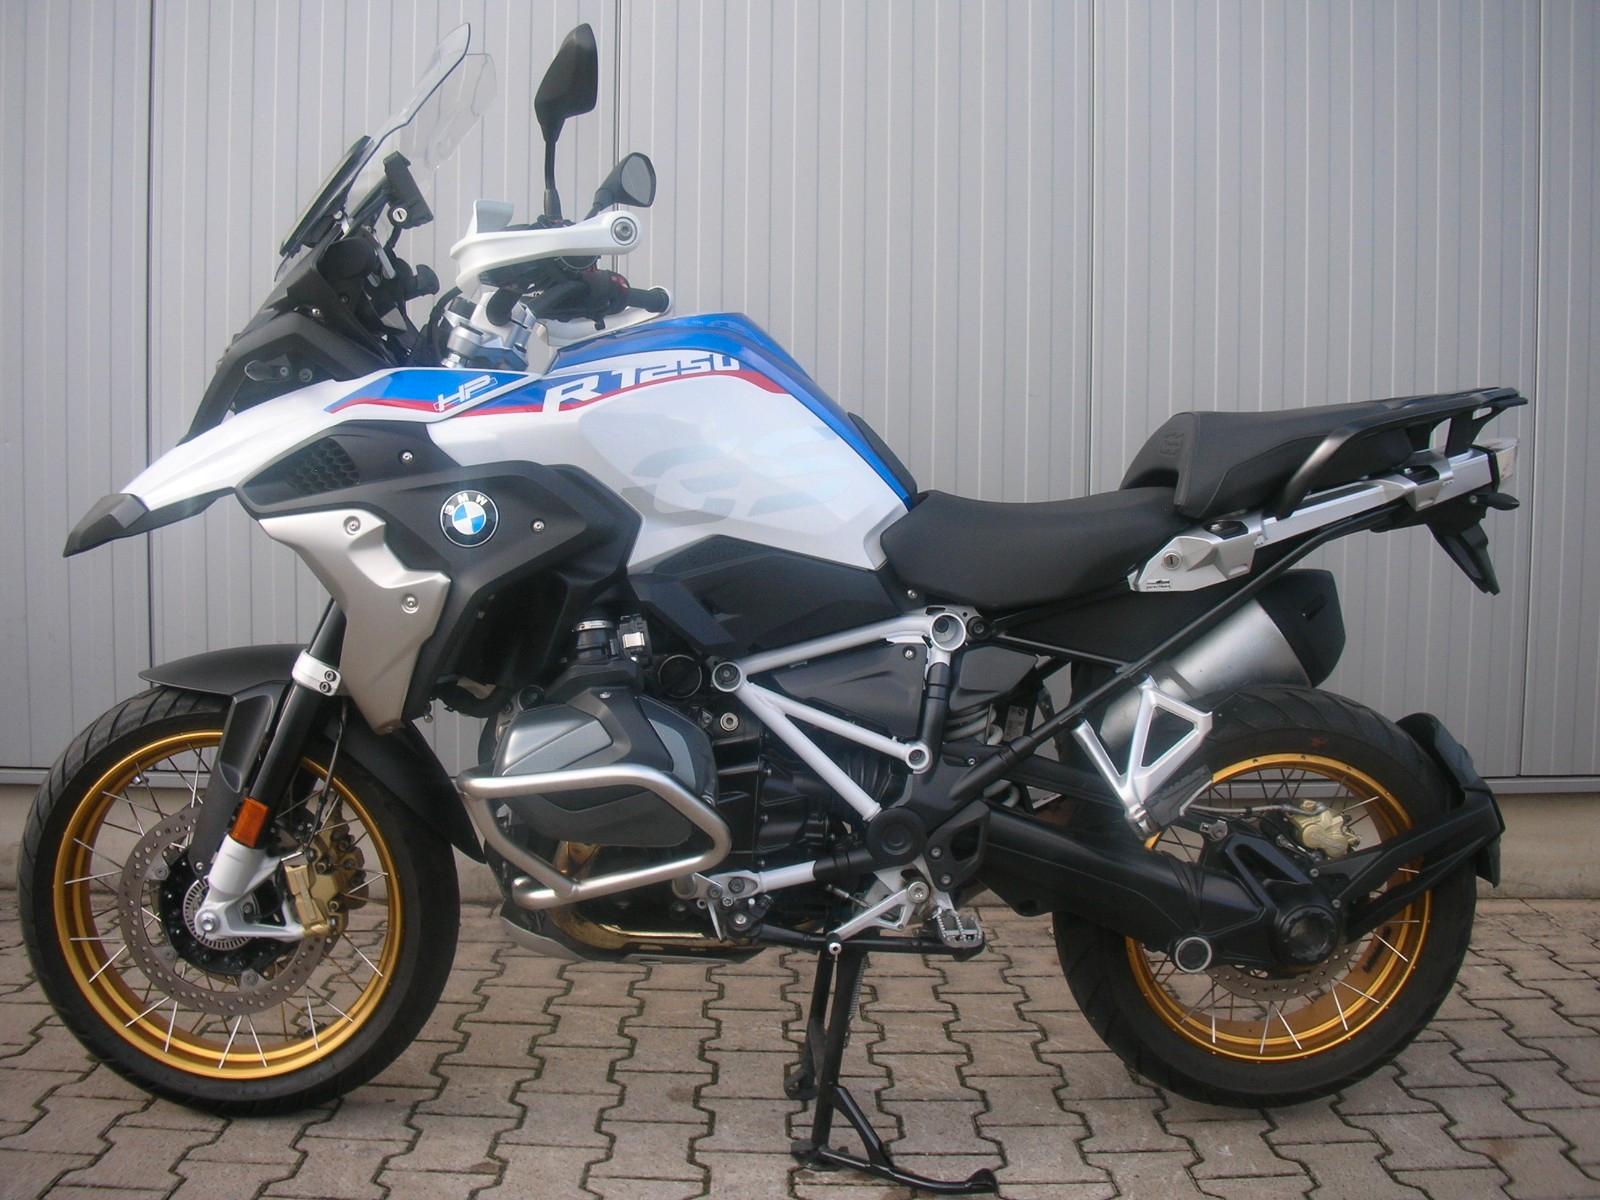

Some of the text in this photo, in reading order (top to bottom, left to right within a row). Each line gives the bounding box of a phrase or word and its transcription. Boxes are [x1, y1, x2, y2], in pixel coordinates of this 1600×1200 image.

[433, 375, 498, 412] HP
[542, 374, 602, 413] R
[444, 492, 489, 516] BMW
